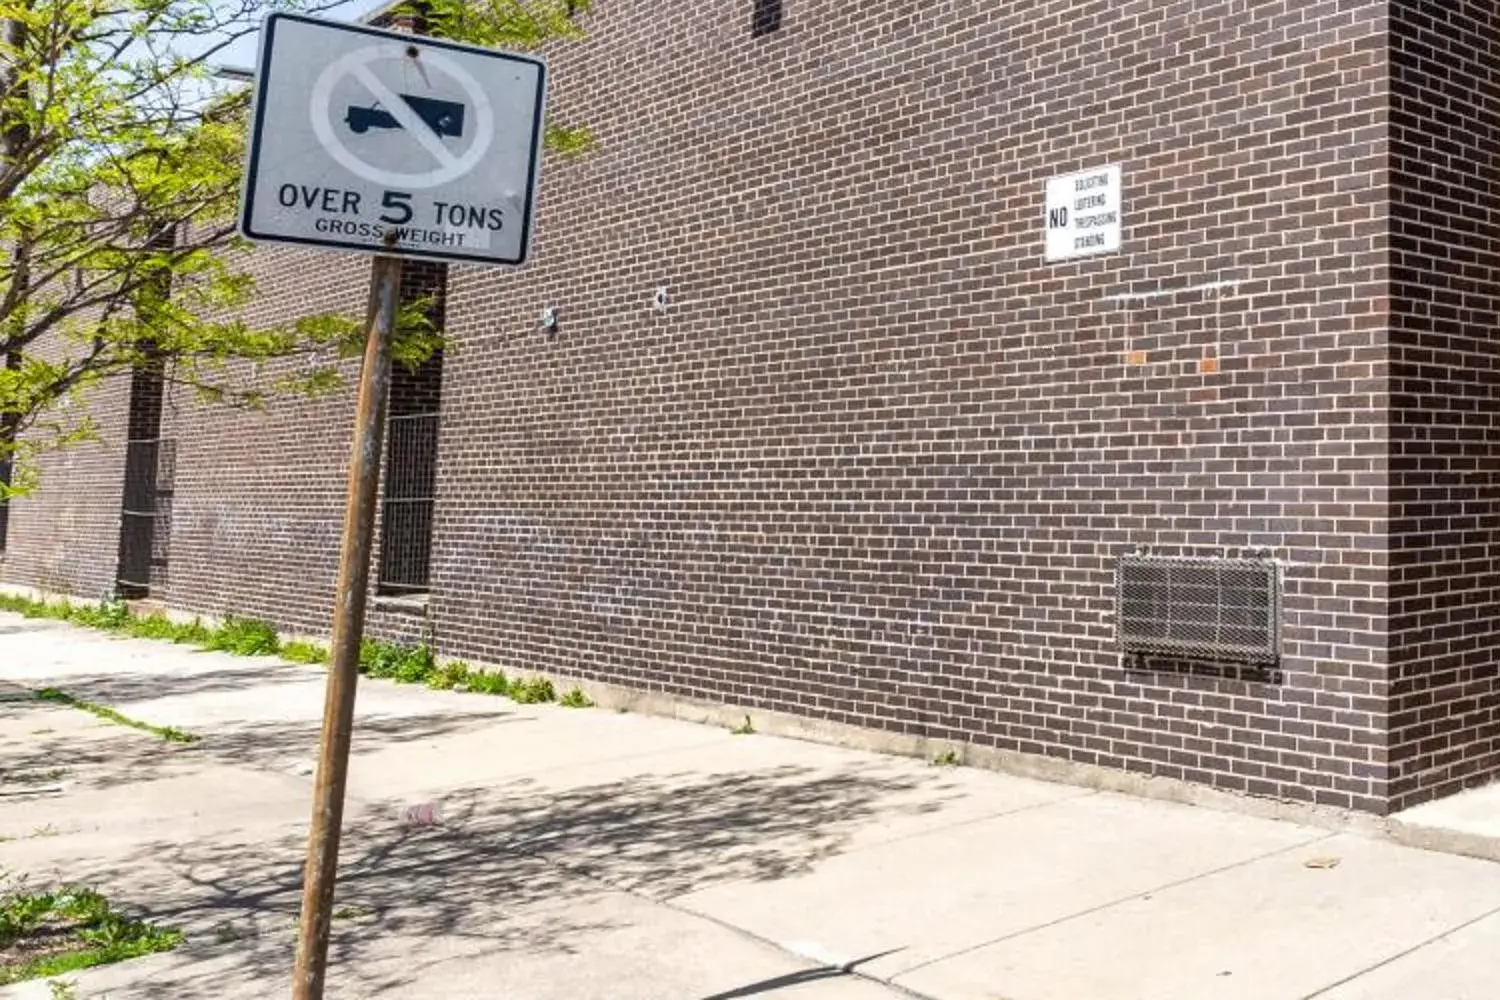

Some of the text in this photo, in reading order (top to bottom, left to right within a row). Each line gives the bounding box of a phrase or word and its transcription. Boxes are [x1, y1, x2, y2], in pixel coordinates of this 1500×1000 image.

[279, 183, 504, 231] OVER 5 TONS
[1049, 206, 1068, 229] NO
[315, 217, 385, 239] GROSS
[393, 227, 466, 247] WEIGHT
